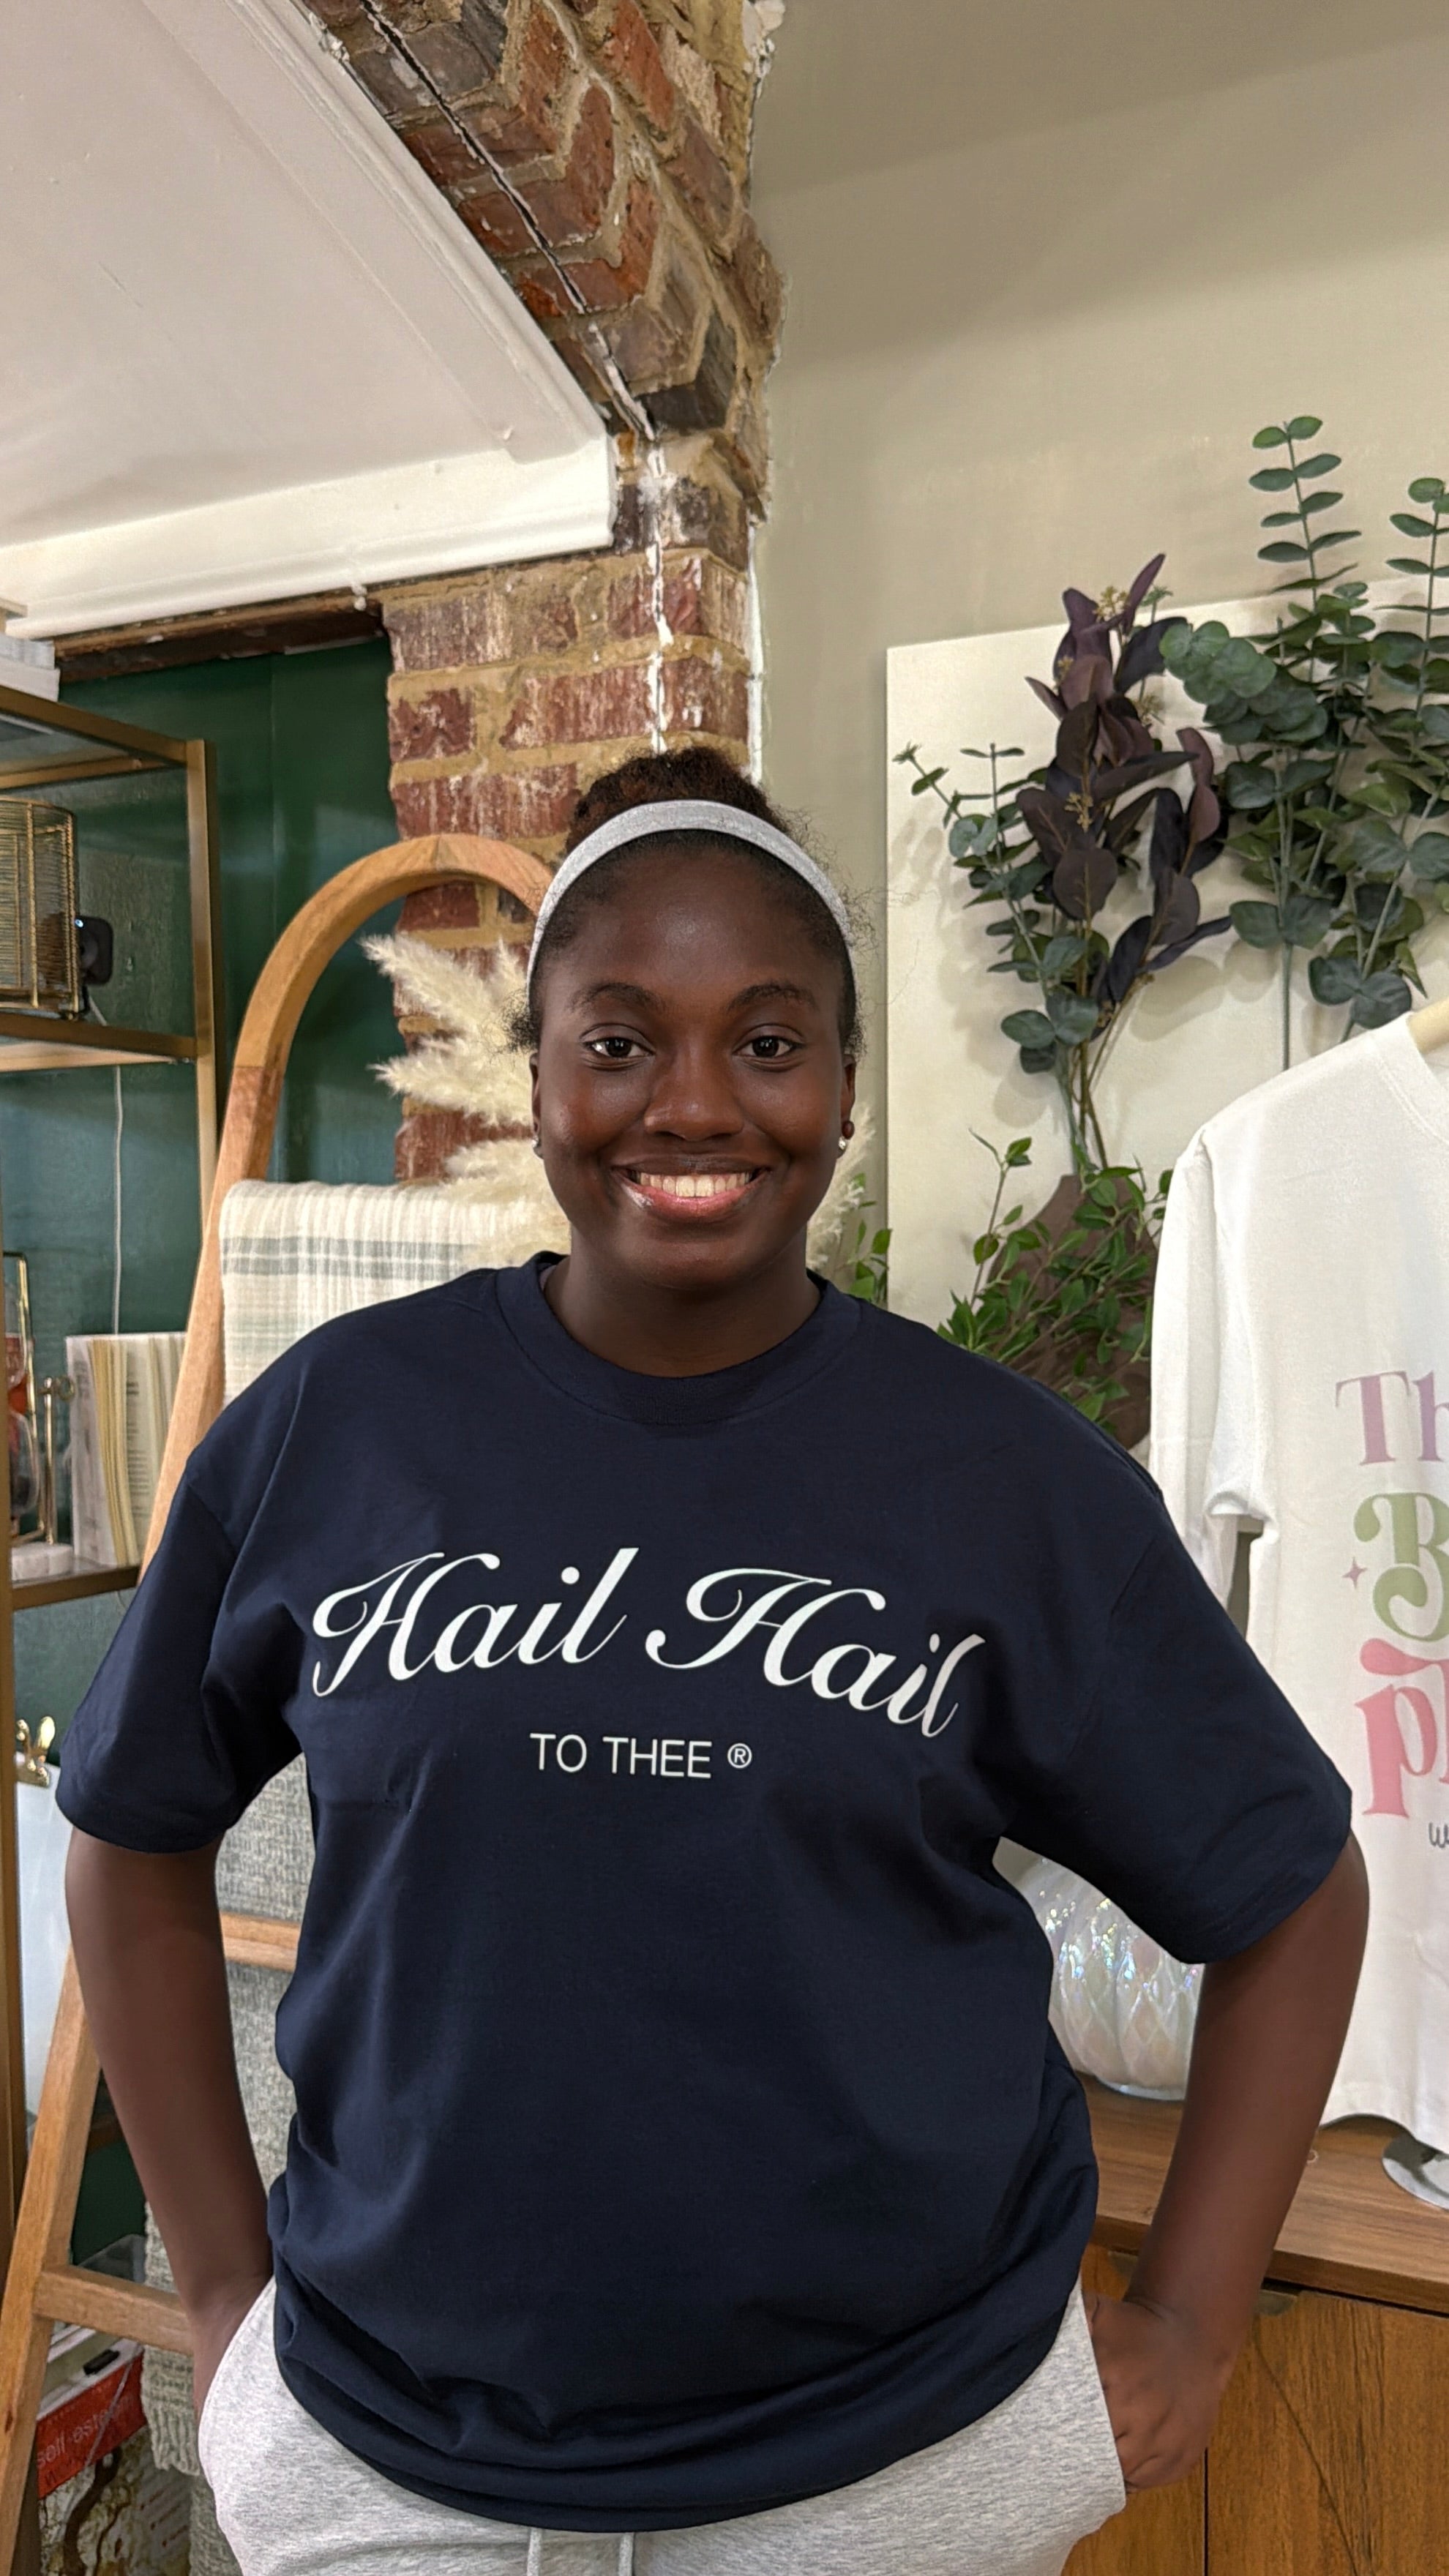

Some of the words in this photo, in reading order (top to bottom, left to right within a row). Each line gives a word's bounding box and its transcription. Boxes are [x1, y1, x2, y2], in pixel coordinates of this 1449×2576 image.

[312, 1547, 640, 1697] Hail
[645, 1568, 986, 1737] Hail
[529, 1732, 587, 1773] TO
[602, 1736, 712, 1778] THEE
